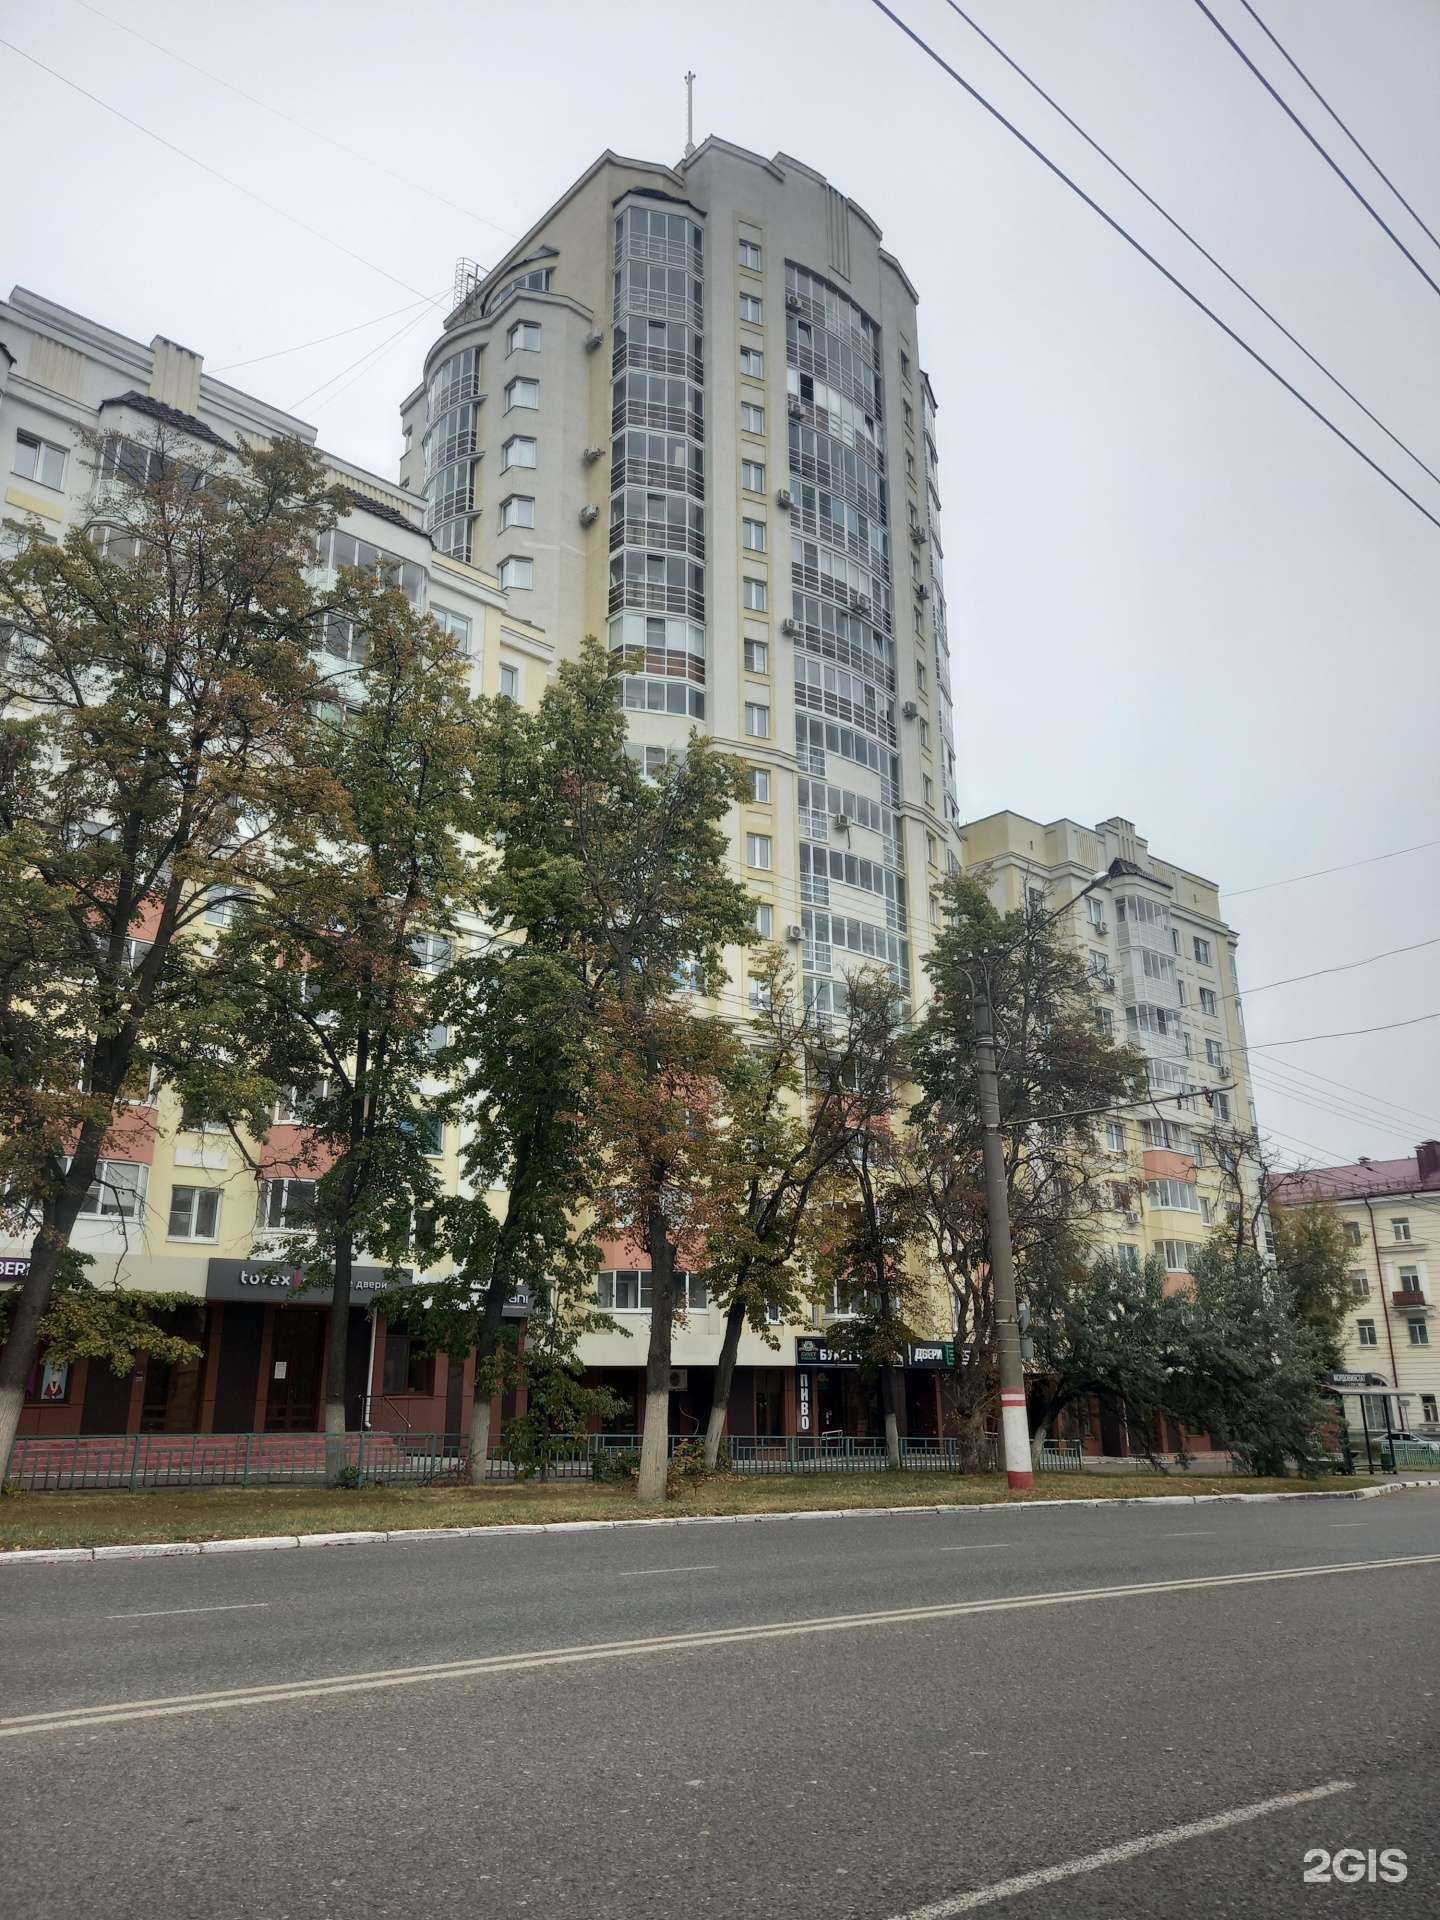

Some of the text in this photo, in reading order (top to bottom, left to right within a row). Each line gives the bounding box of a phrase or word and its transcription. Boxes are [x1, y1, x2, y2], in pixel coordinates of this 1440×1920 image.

[240, 1270, 291, 1286] torex
[355, 1280, 388, 1290] двери
[914, 1348, 943, 1362] ДВЕРИ
[800, 1373, 810, 1430] ПИВО
